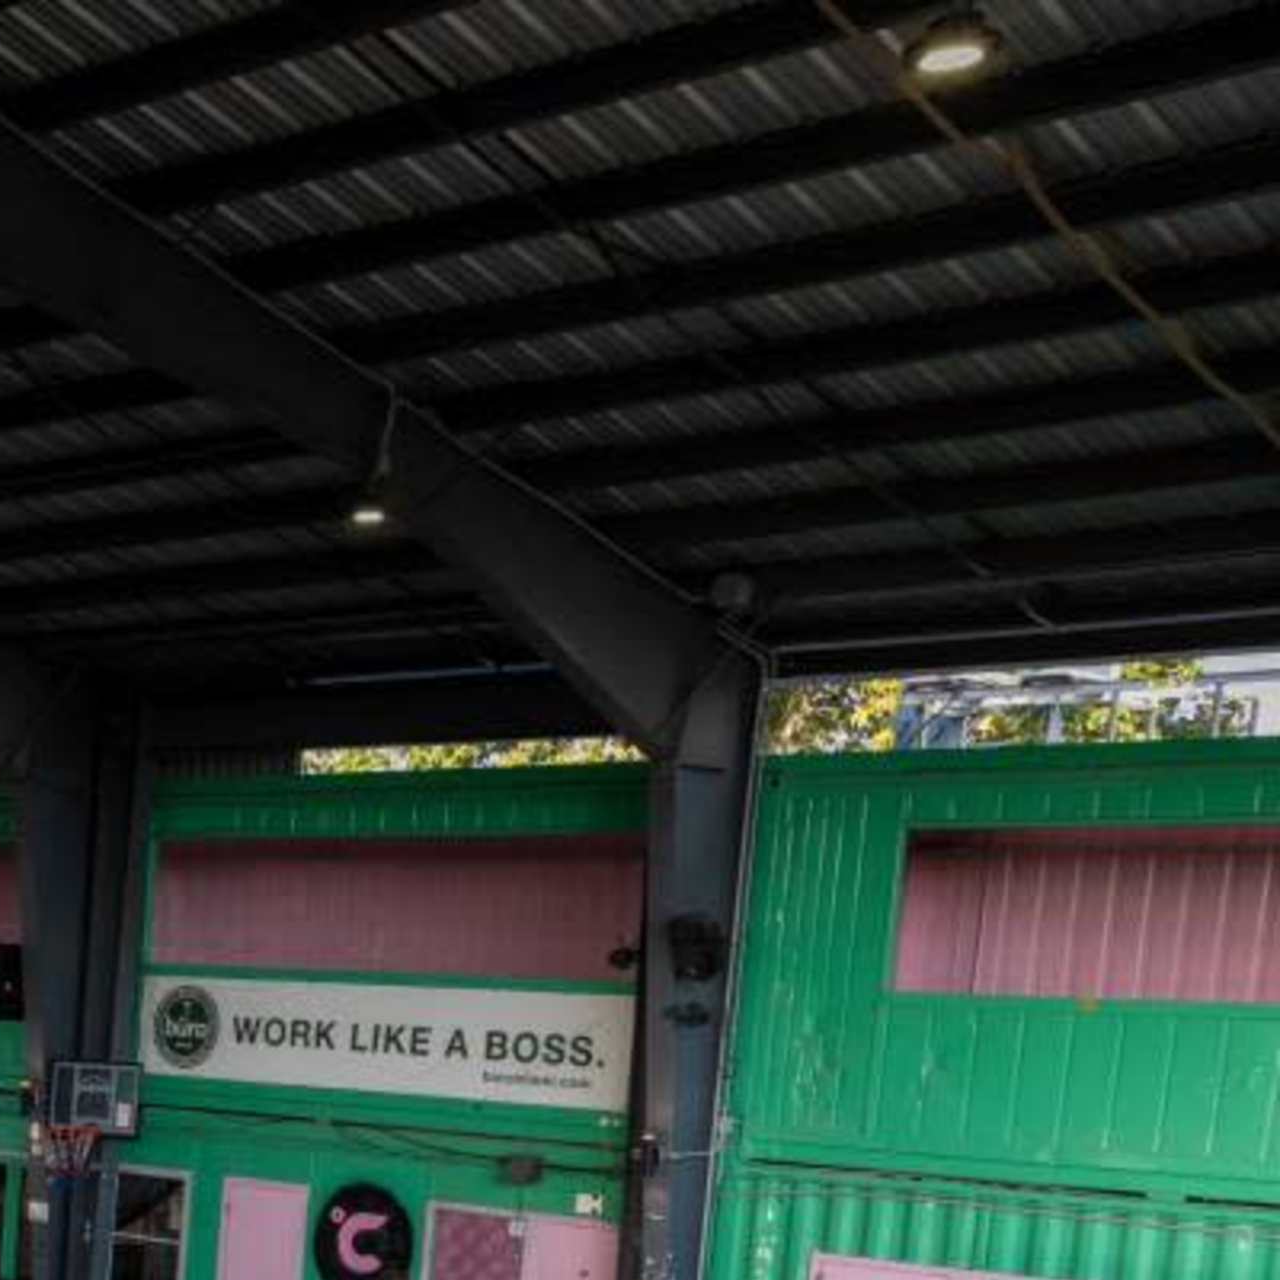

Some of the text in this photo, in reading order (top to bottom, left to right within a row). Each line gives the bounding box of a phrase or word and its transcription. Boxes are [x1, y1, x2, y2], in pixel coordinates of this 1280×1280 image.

[232, 1014, 606, 1069] WORK LIKE A BOSS.
